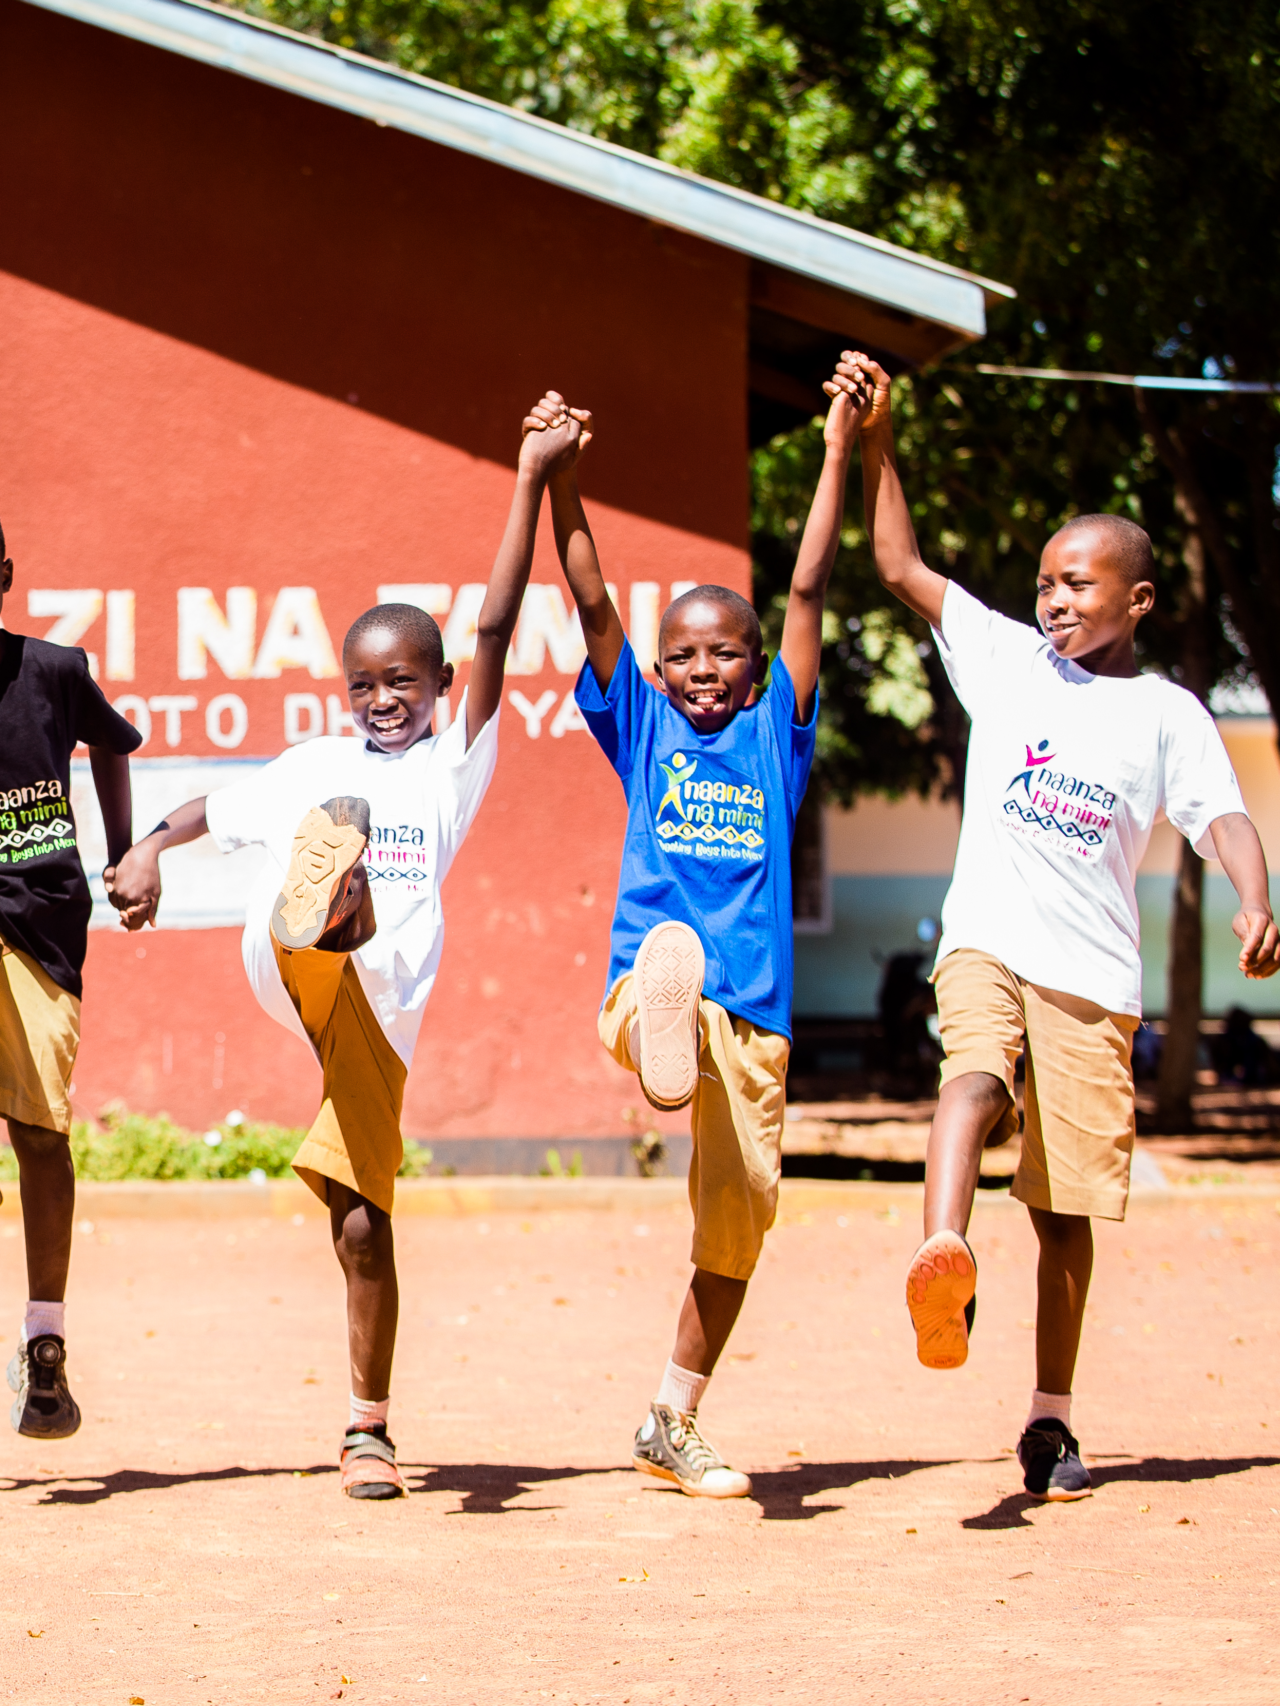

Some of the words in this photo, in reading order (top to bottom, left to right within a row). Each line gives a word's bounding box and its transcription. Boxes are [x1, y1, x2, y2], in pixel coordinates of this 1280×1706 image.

[176, 585, 341, 681] NA
[683, 780, 764, 811] naanza
[1037, 768, 1116, 811] naanza
[19, 796, 68, 824] mimi
[686, 803, 715, 824] na
[718, 805, 765, 831] mimi
[1031, 790, 1059, 814] na
[1062, 803, 1113, 831] mimi
[370, 825, 424, 846] anza
[10, 847, 34, 864] Boys
[33, 842, 54, 856] Into
[53, 837, 76, 851] Men
[378, 846, 426, 864] mimi
[695, 842, 721, 857] Boys
[721, 844, 741, 859] Into
